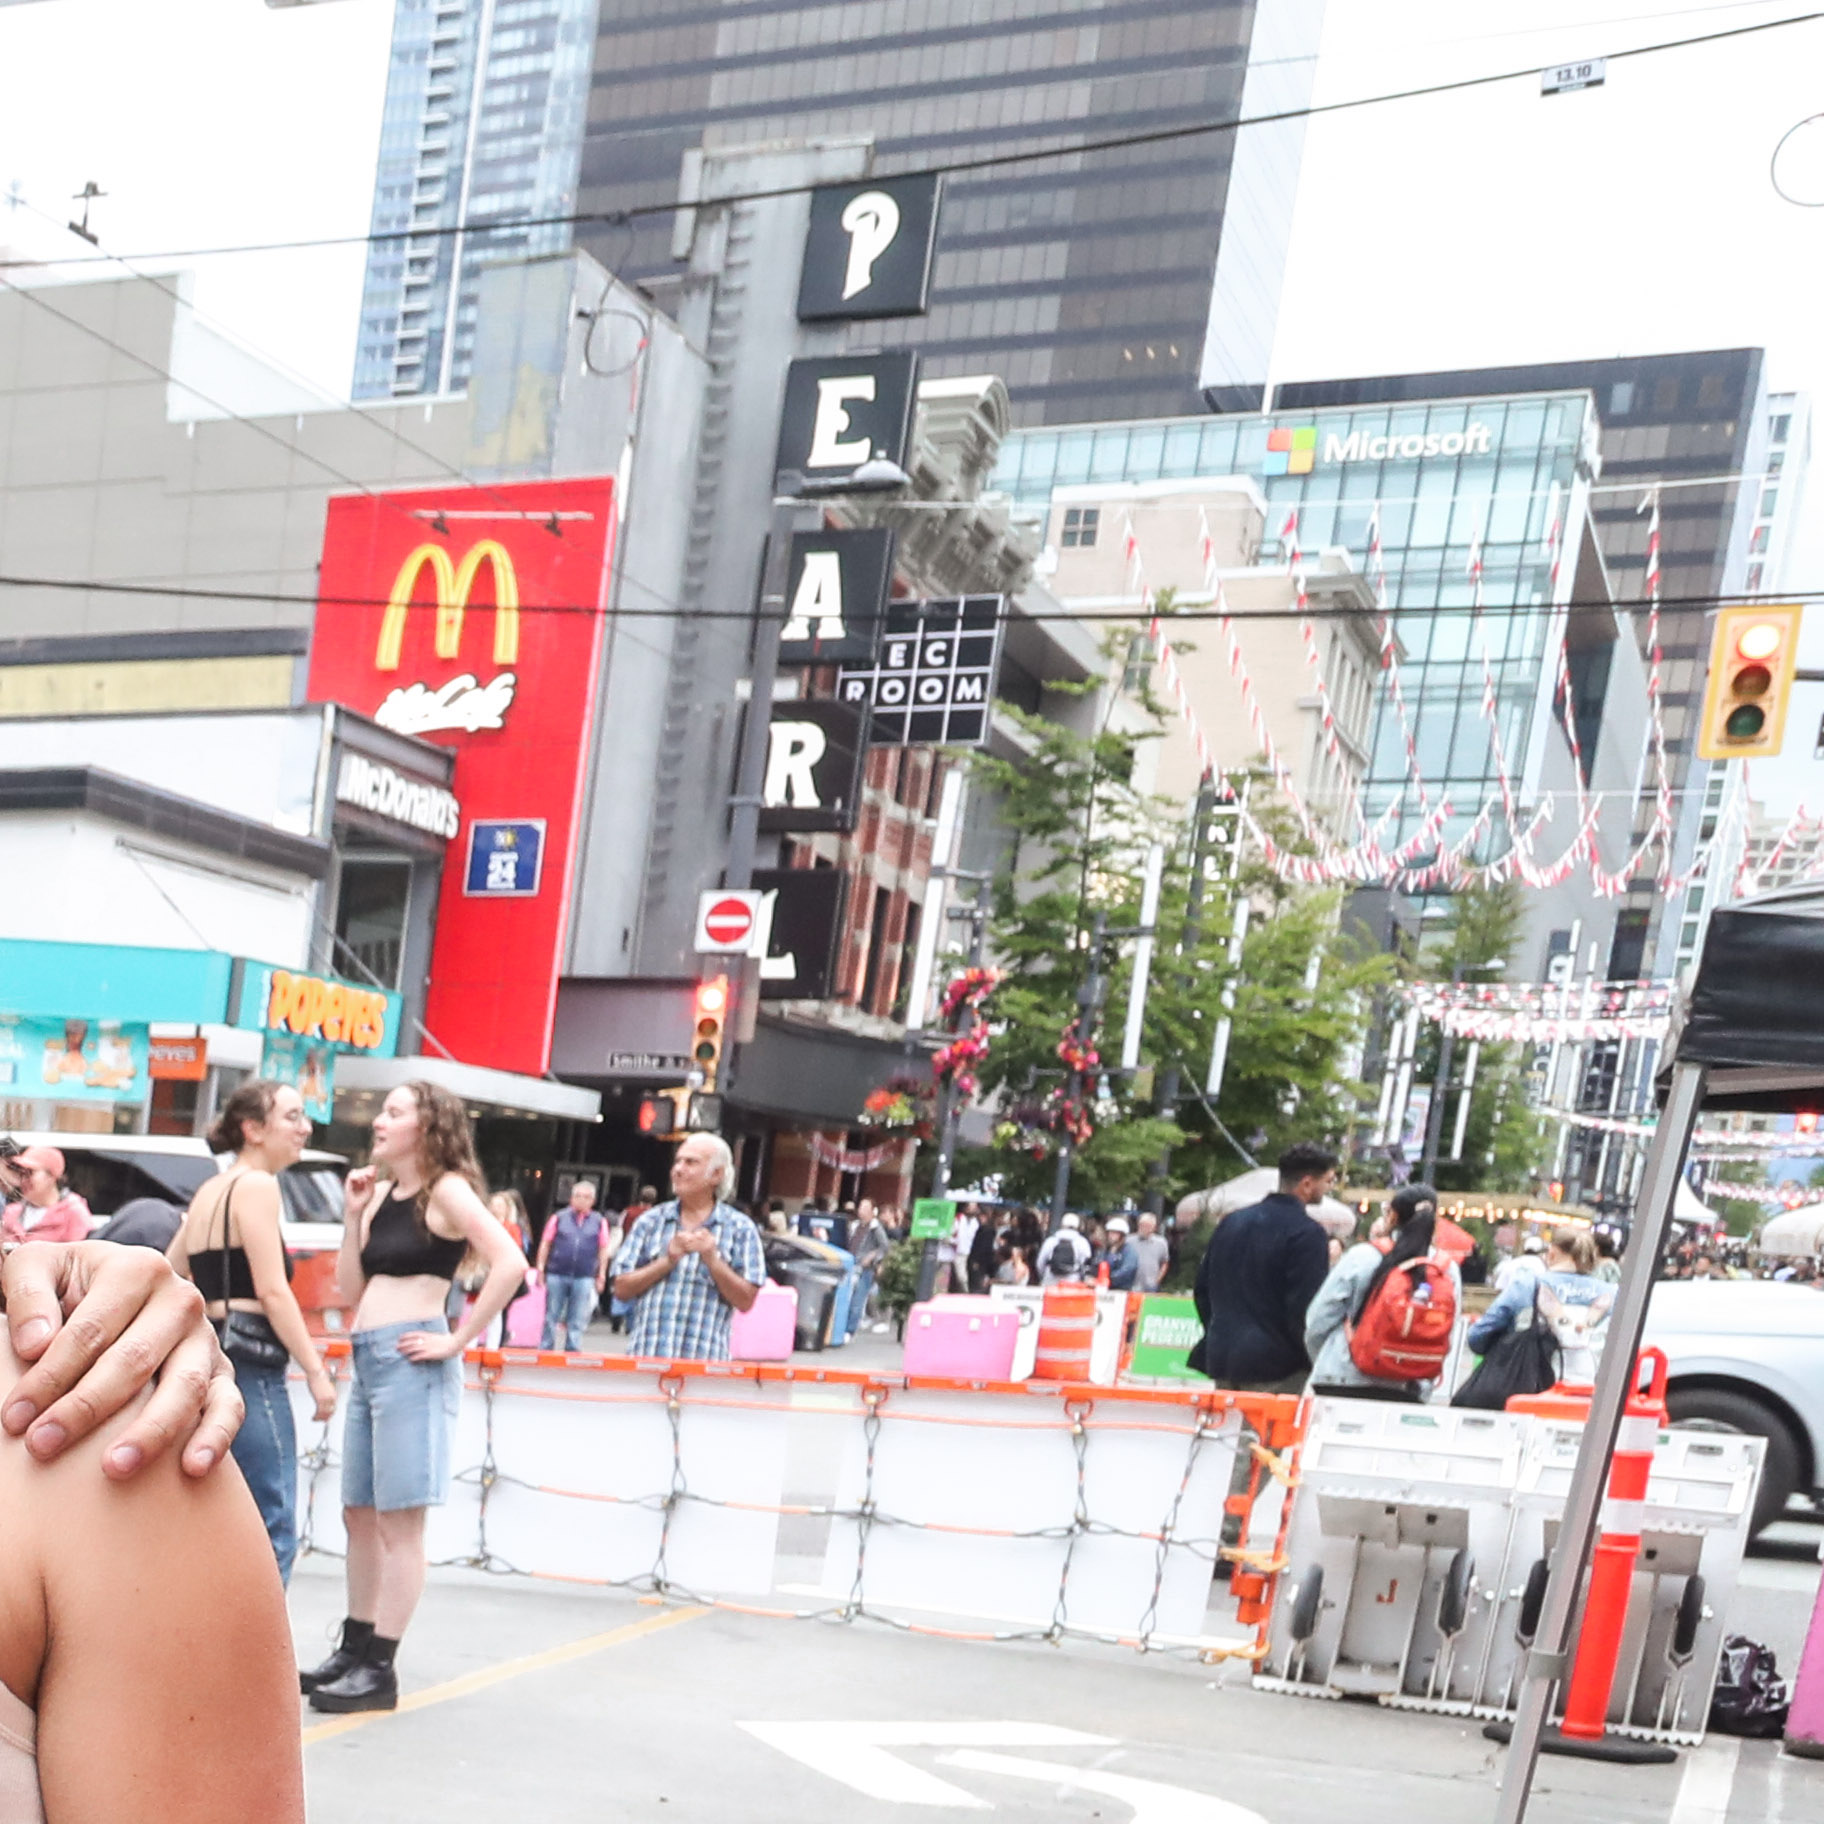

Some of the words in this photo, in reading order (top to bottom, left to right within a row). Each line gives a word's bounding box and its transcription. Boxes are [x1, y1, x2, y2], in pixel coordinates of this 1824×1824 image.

[1323, 421, 1493, 464] Microsoft
[888, 641, 948, 668] EC
[846, 676, 983, 704] ROOM
[336, 753, 461, 839] McDonald's
